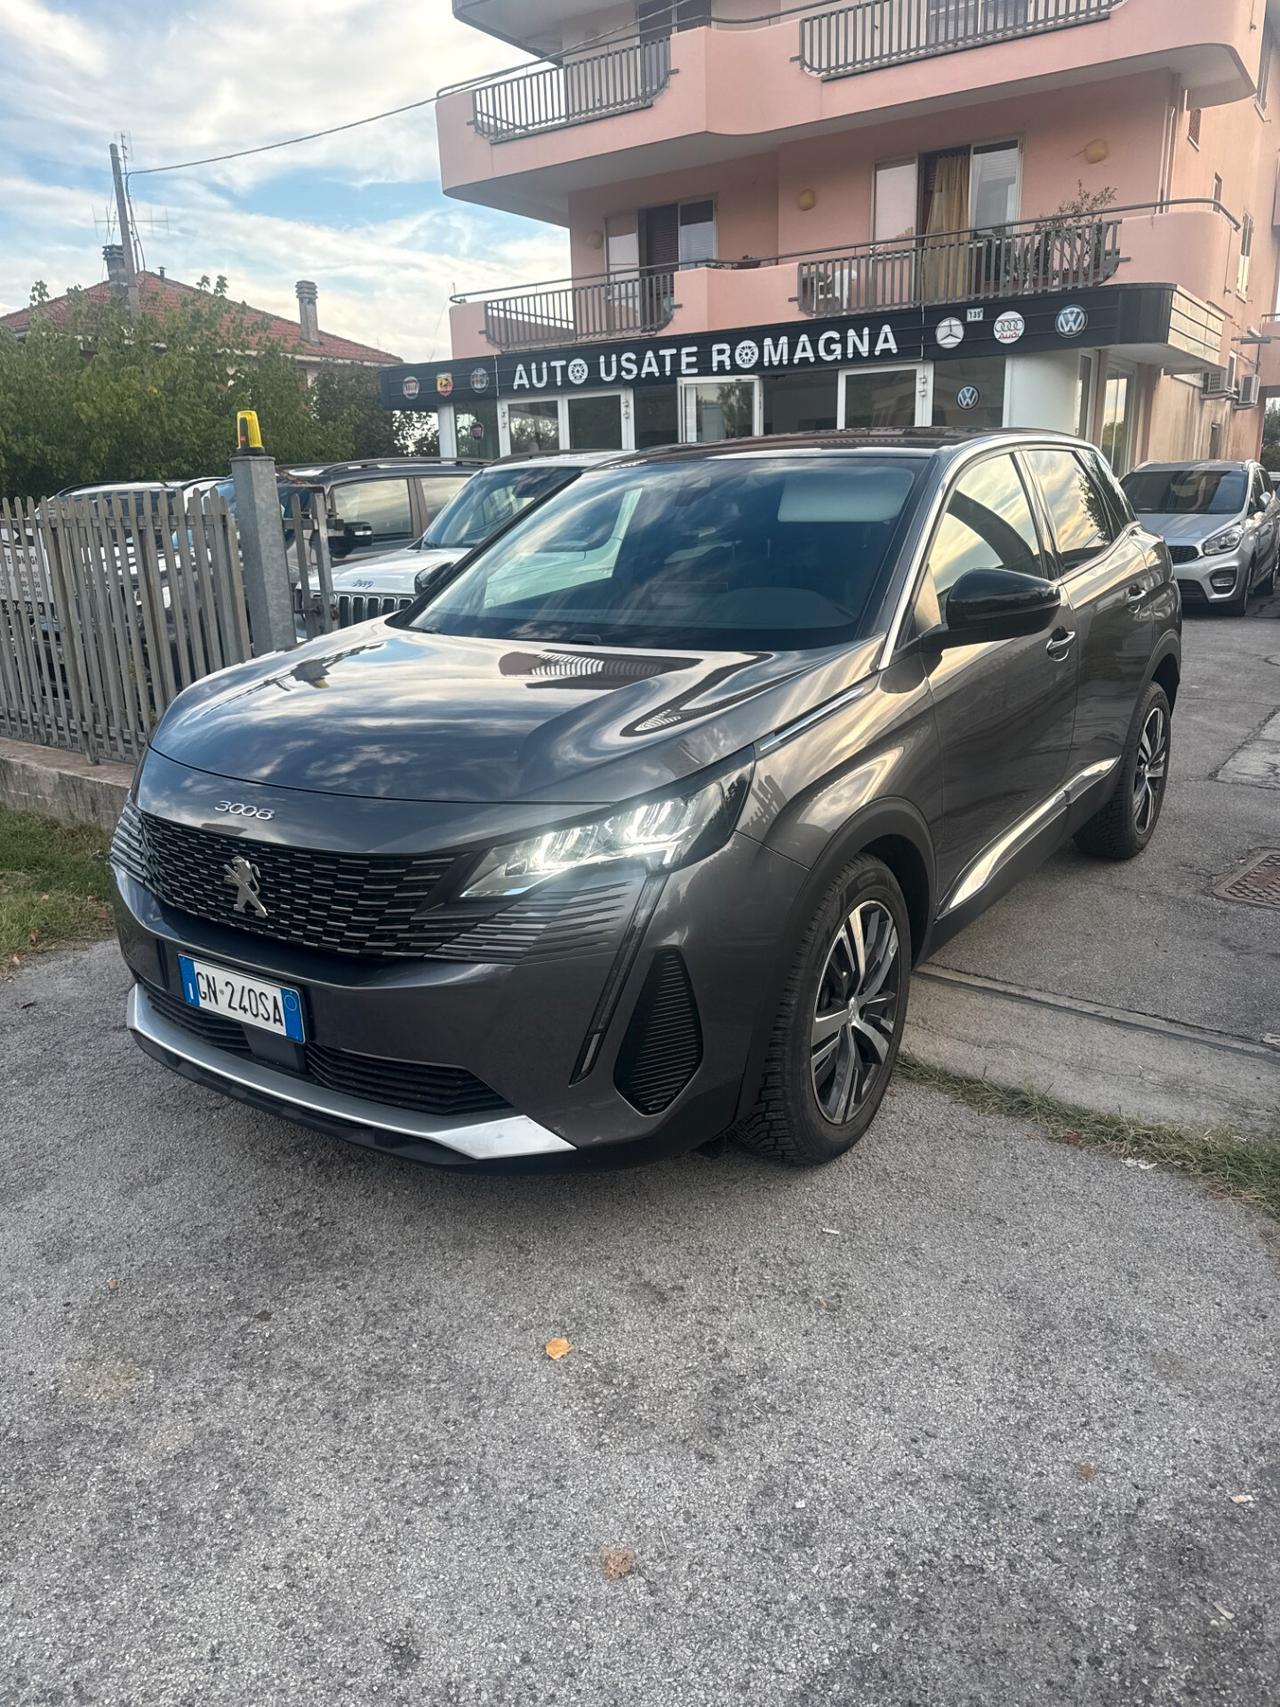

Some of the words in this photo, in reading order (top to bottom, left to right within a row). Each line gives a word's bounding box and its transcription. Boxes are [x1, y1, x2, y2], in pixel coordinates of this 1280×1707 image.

[512, 357, 589, 391] AUTO
[599, 345, 699, 382] USATE
[711, 323, 898, 373] ROMAGNA
[214, 800, 275, 820] 3008
